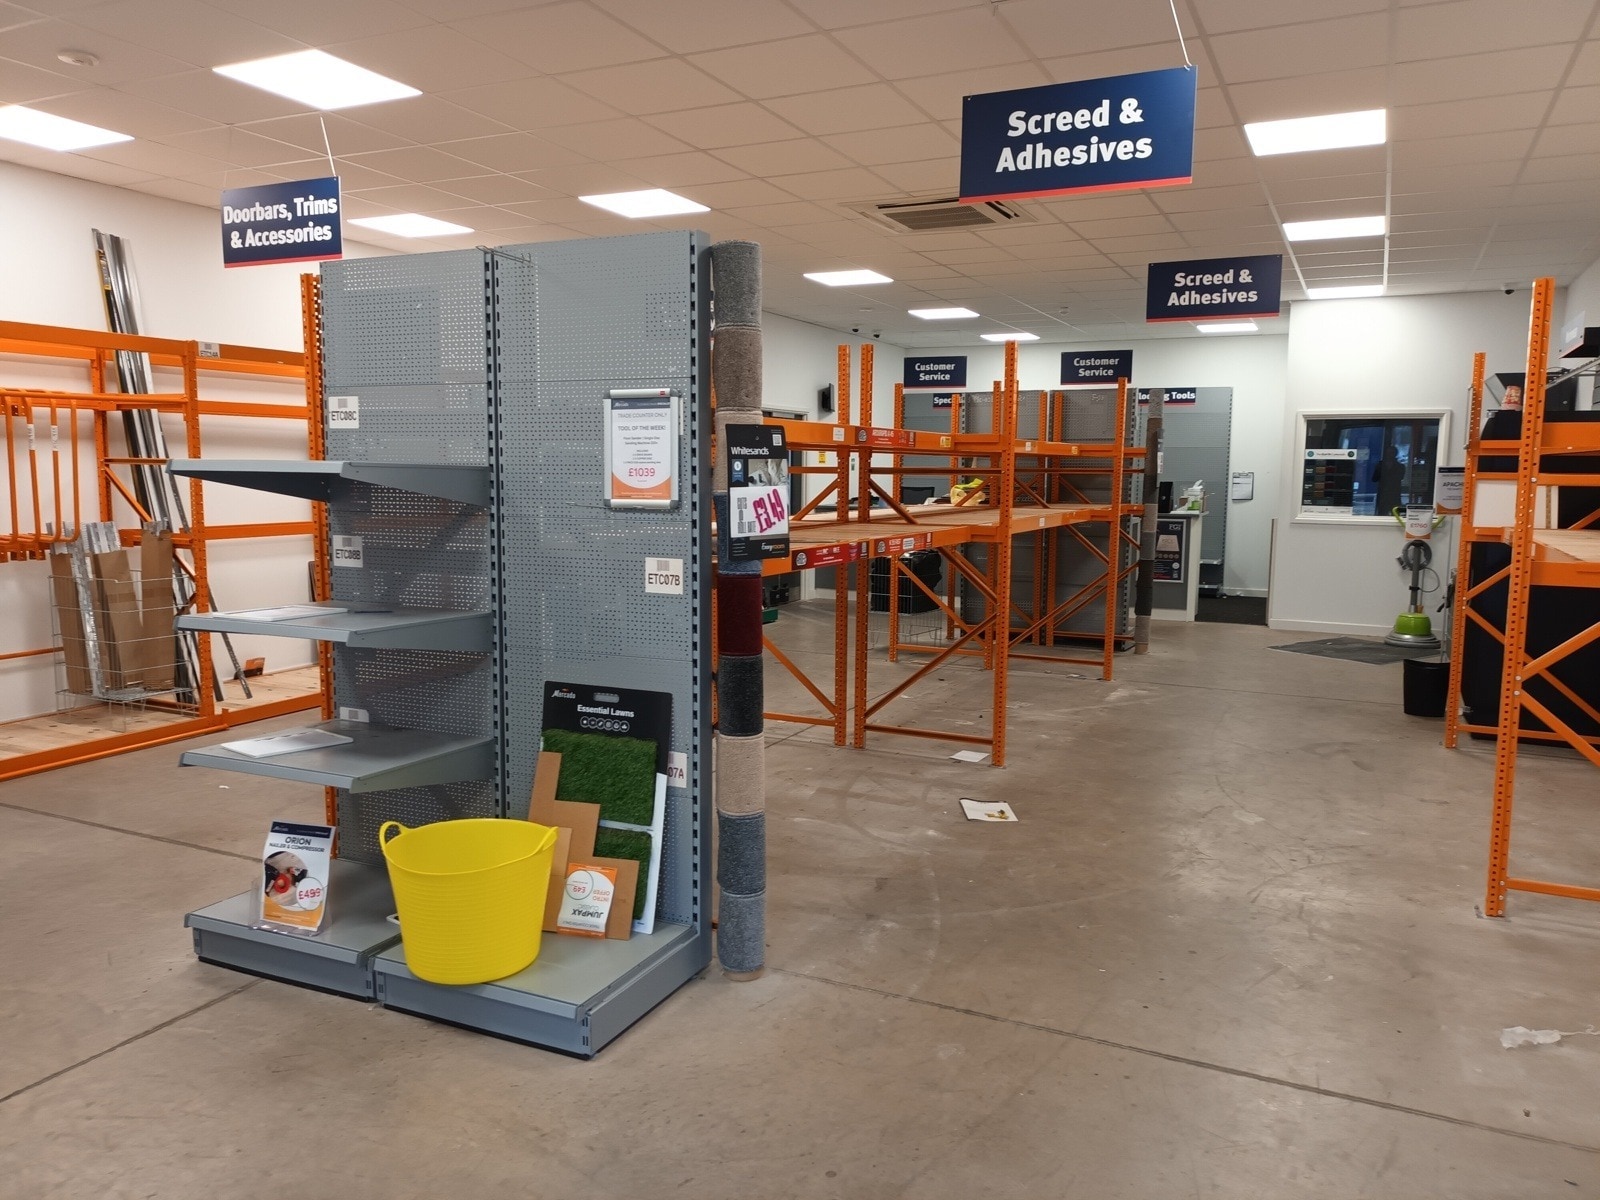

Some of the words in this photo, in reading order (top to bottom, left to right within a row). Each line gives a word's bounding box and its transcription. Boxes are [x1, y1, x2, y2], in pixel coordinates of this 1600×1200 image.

[1007, 99, 1110, 137] Screed
[1119, 97, 1144, 124] &
[995, 135, 1153, 173] Adhesives
[223, 201, 293, 225] Doorbars,
[293, 194, 338, 217] Trims
[230, 230, 243, 249] &
[245, 220, 332, 248] Accessories
[1173, 269, 1234, 287] Screed
[1238, 268, 1253, 283] &
[1167, 288, 1258, 307] Adhesives
[914, 362, 956, 371] Customer
[1073, 357, 1119, 366] Customer
[918, 371, 951, 381] Service
[1078, 367, 1114, 377] Service
[1170, 391, 1196, 400] Tools
[731, 446, 769, 455] Whitesands
[628, 467, 656, 477] £1039
[648, 573, 681, 586] ETC07B
[551, 689, 576, 699] Mercado
[576, 704, 610, 715] Essential
[610, 707, 635, 718] Lawns
[667, 766, 685, 780] 07A
[285, 836, 312, 845] ORION
[291, 844, 325, 853] COMPRESSOR
[298, 887, 321, 900] £499
[572, 909, 604, 918] JUMPAX
